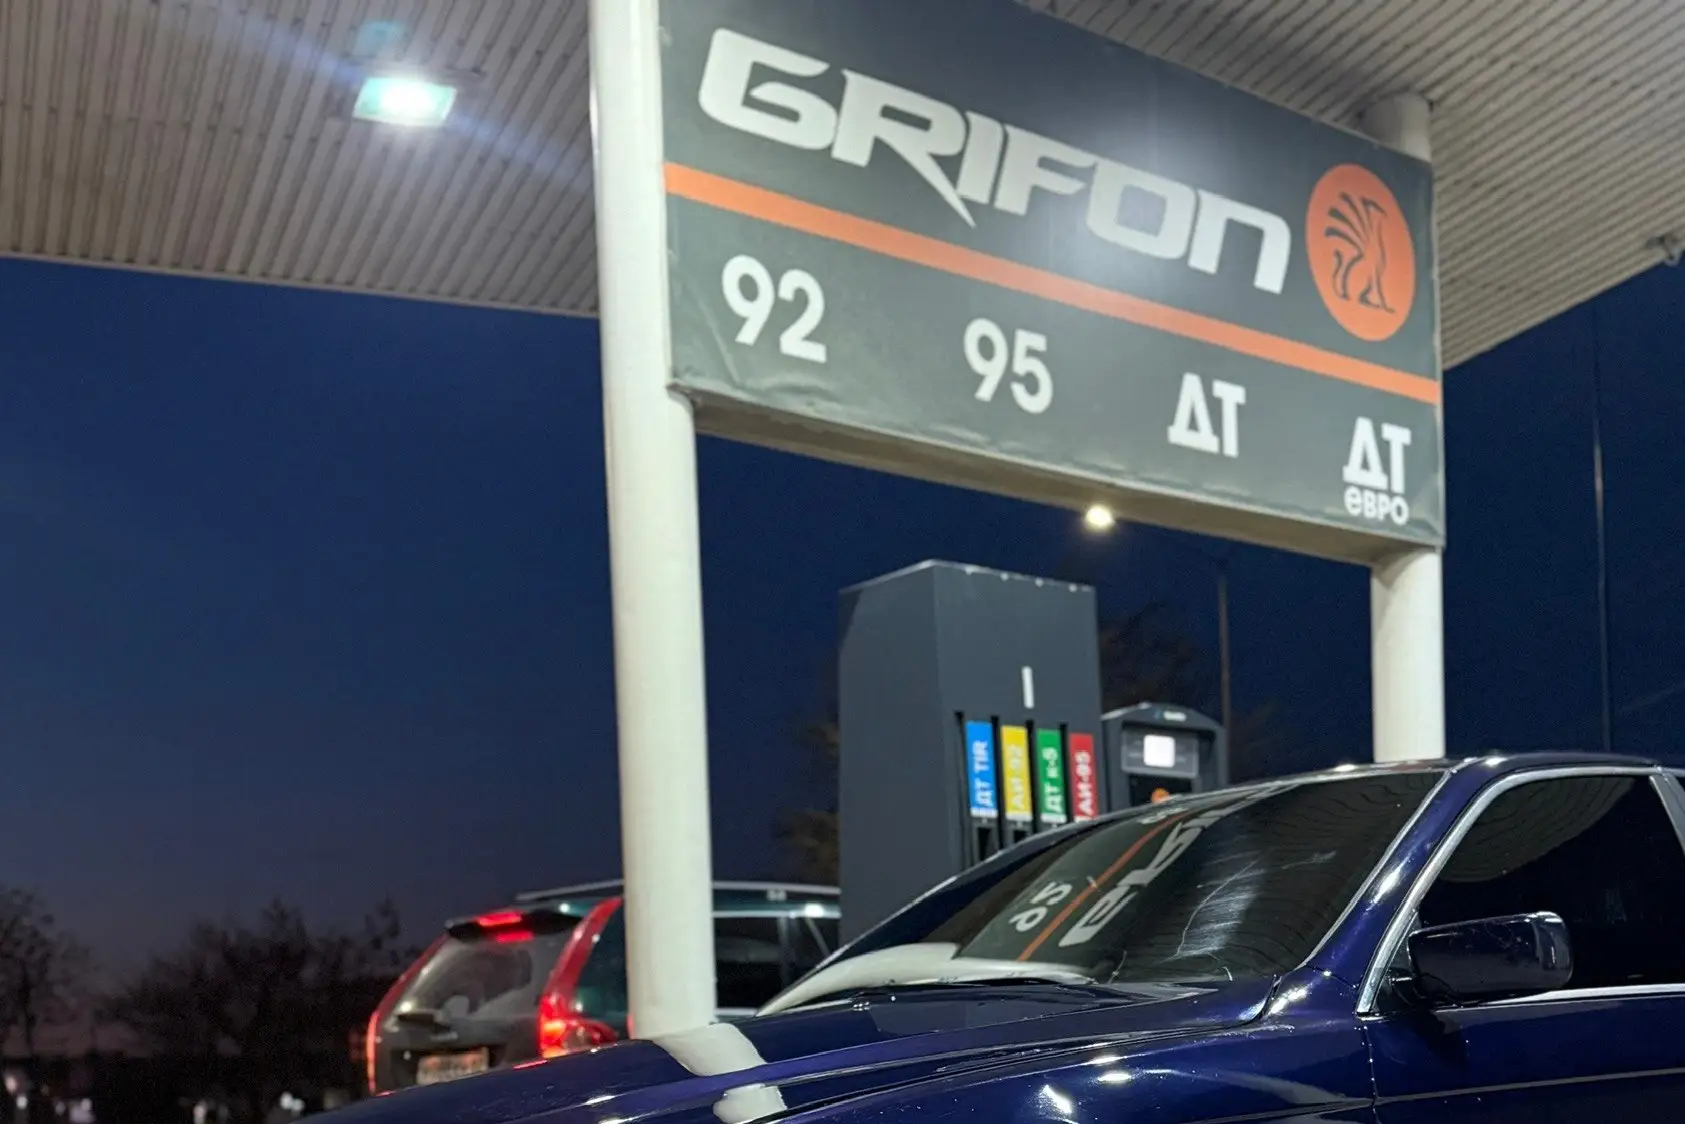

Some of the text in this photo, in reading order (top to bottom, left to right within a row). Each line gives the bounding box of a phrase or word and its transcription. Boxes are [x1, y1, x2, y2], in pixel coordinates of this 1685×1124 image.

[698, 27, 1292, 294] GRIFON
[721, 254, 827, 363] 92
[963, 317, 1054, 414] 95
